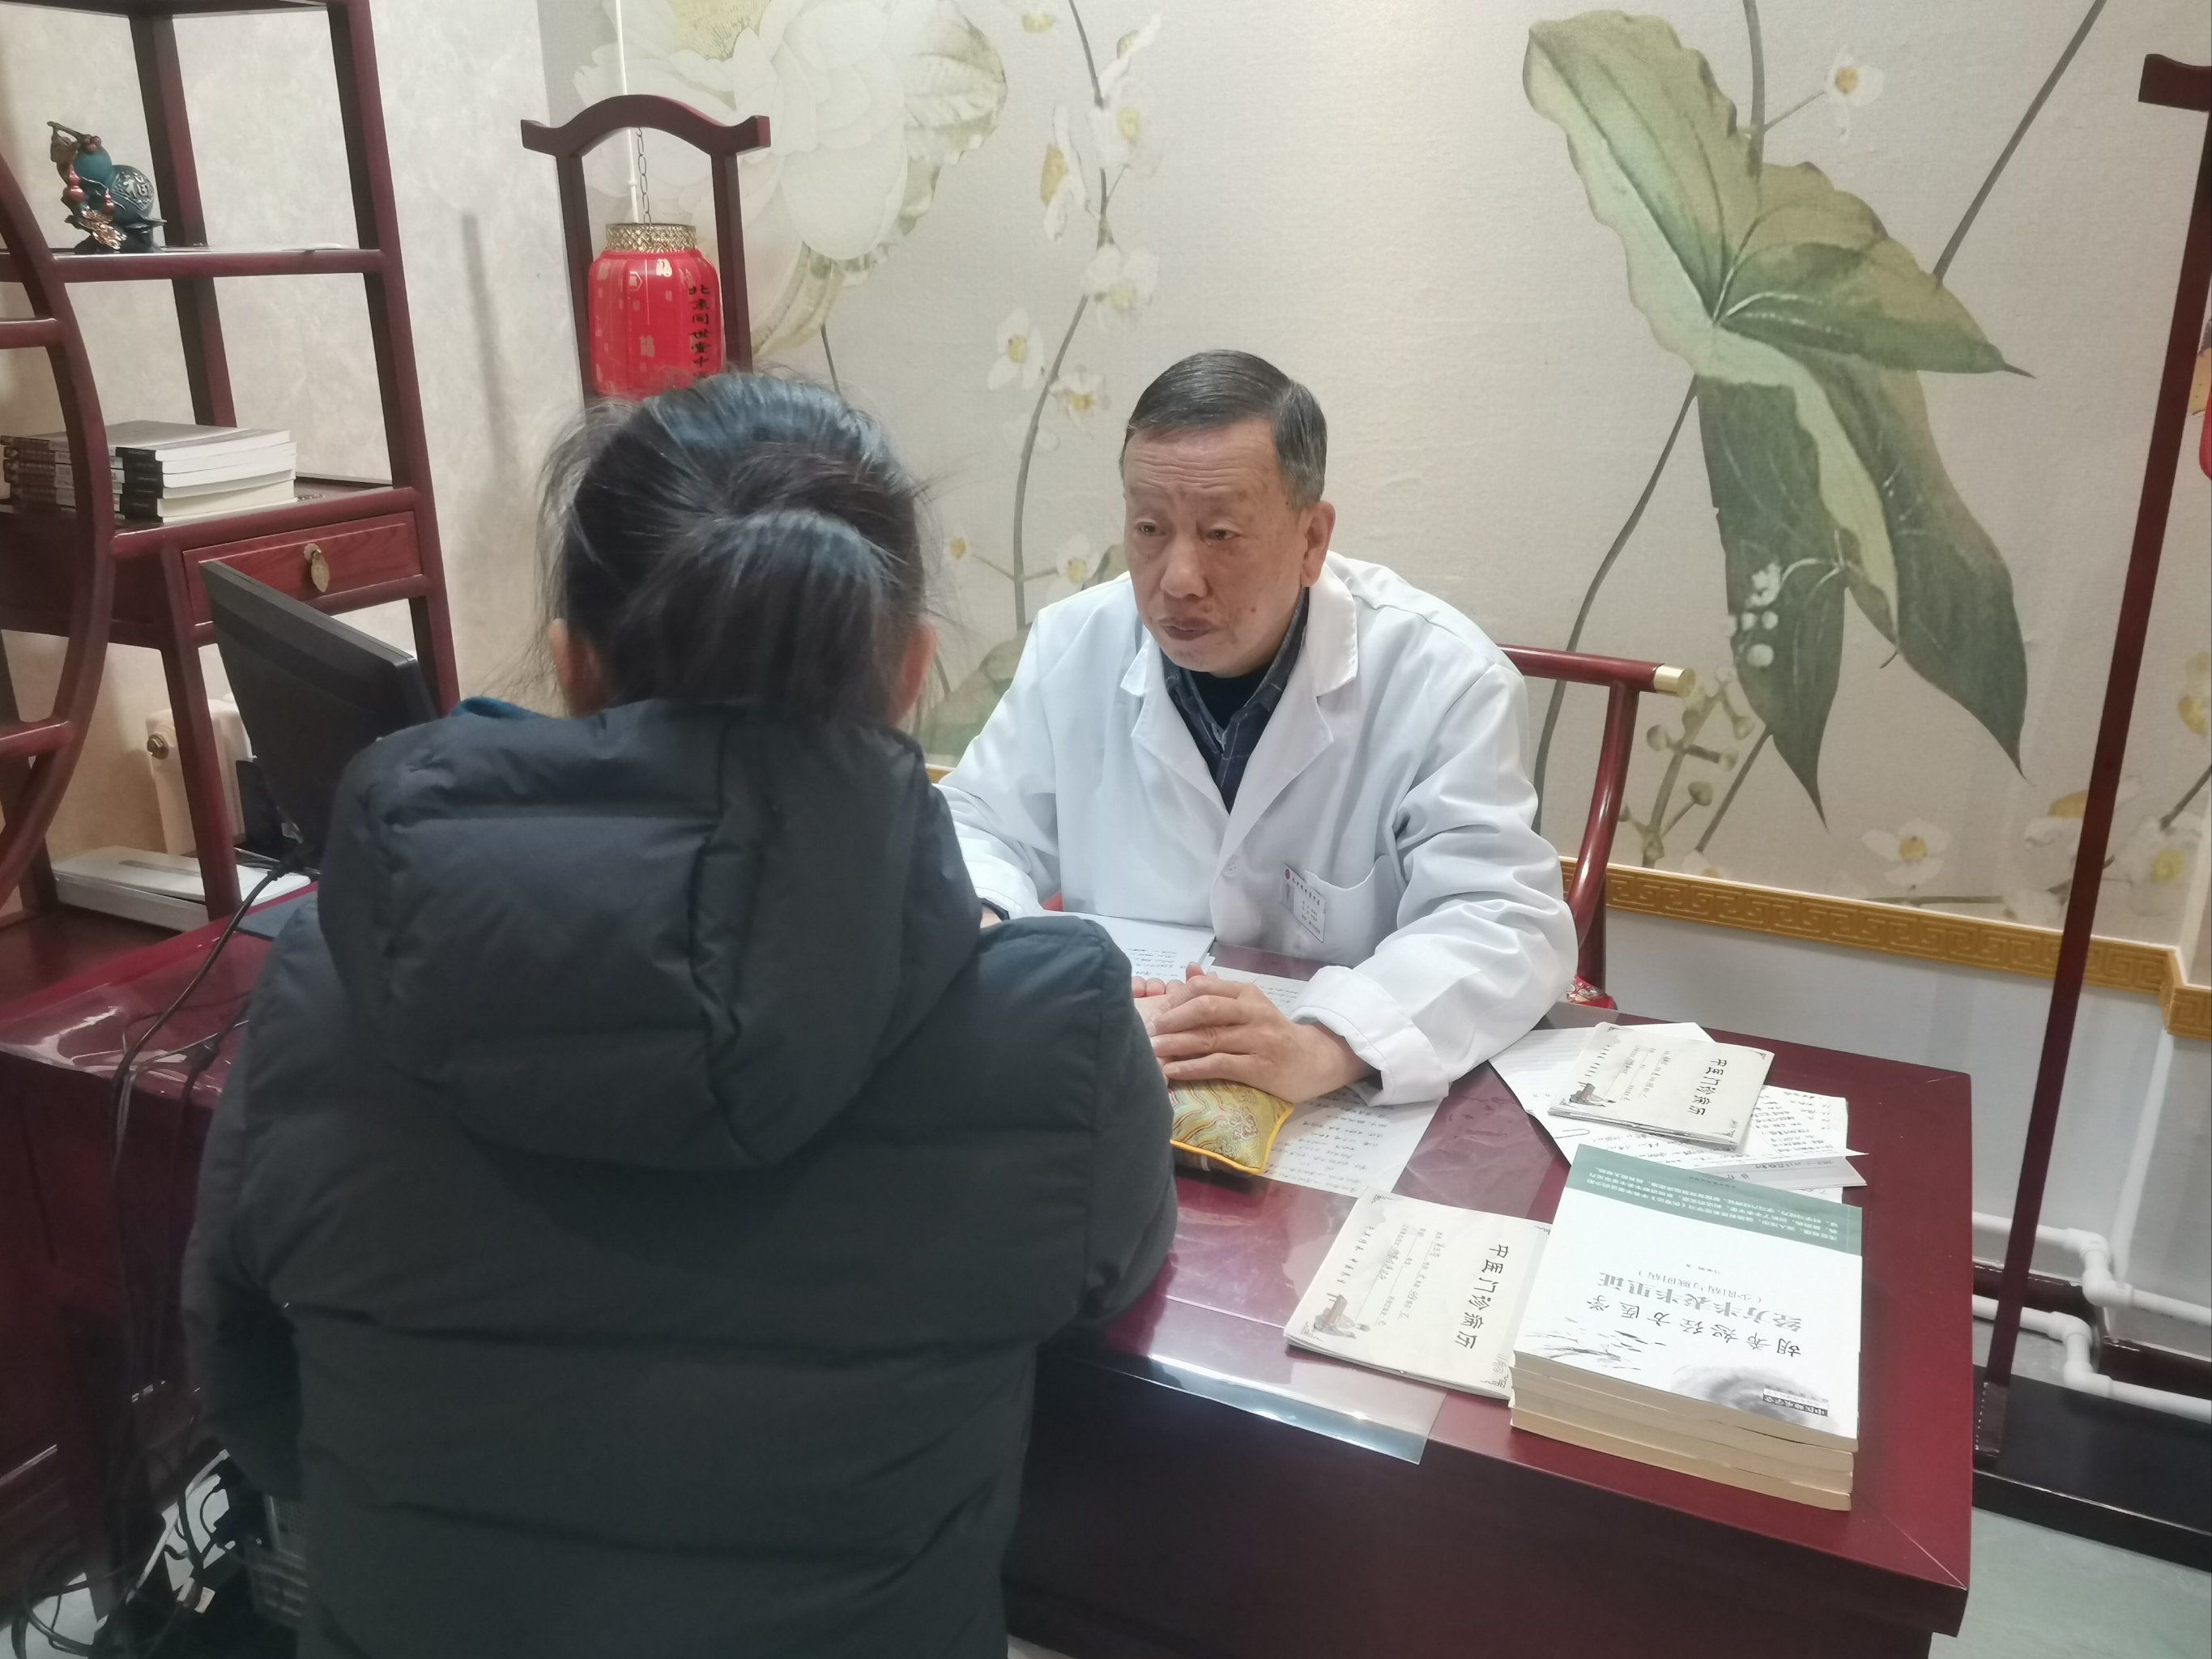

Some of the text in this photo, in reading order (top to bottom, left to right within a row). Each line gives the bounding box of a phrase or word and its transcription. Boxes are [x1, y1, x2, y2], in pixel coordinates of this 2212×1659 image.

[1454, 1243, 1509, 1350] 中医门诊病历
[1586, 1294, 1801, 1358] 胡希恕经方医学
[1598, 1272, 1802, 1333] 经方半表半里证
